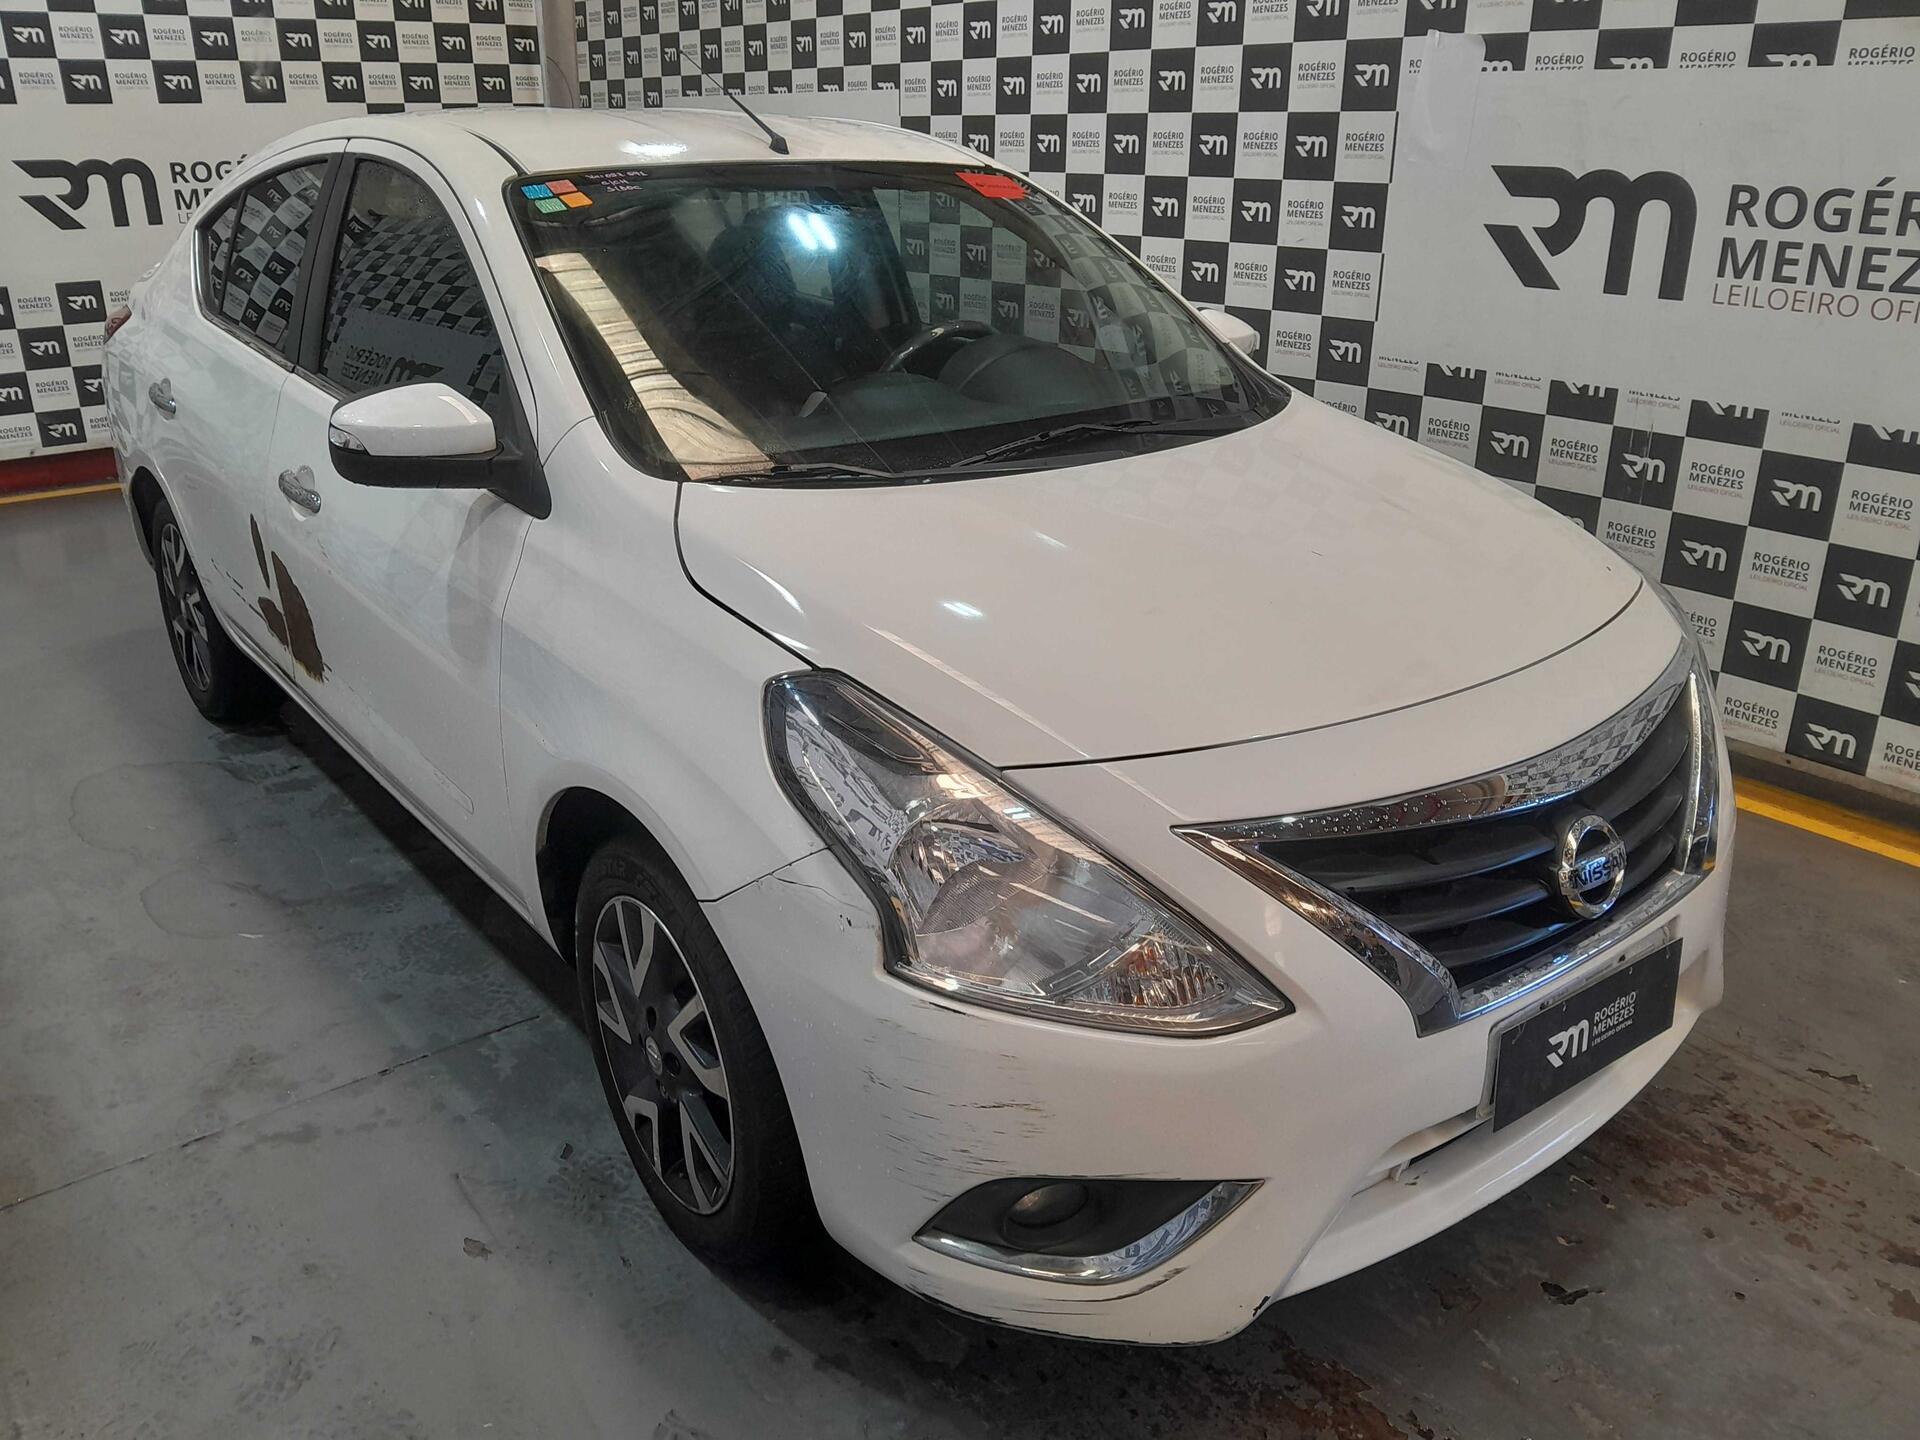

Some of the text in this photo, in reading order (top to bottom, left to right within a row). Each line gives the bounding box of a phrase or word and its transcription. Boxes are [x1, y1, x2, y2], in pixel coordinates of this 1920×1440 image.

[1076, 8, 1104, 17] ROGÉRIO
[1160, 1, 1191, 10] ROGÉRIO
[1207, 0, 1237, 23] RM
[1252, 3, 1288, 14] MENEZES
[1002, 15, 1027, 23] ROGÉRIO
[1076, 17, 1104, 26] MENEZES
[1119, 8, 1145, 29] RM
[1159, 10, 1191, 20] MENEZES
[875, 26, 896, 35] ROGÉRIO
[936, 20, 958, 29] ROGÉRIO
[969, 21, 991, 39] RM
[1002, 23, 1027, 31] MENEZES
[1040, 15, 1064, 34] RM
[11, 26, 46, 43] RM
[109, 29, 140, 45] RM
[200, 31, 228, 46] RM
[285, 33, 312, 48] RM
[366, 34, 391, 49] RM
[820, 31, 839, 39] ROGÉRIO
[849, 31, 866, 48] RM
[906, 26, 925, 44] RM
[442, 36, 466, 50] RM
[514, 38, 535, 52] RM
[796, 36, 812, 52] RM
[1536, 53, 1584, 65] ROGÉRIO
[1680, 49, 1736, 62] ROGÉRIO
[1849, 44, 1915, 59] ROGÉRIO
[1114, 69, 1143, 78] ROGÉRIO
[1201, 65, 1233, 74] ROGÉRIO
[1298, 61, 1336, 72] ROGÉRIO
[70, 74, 102, 90] RM
[164, 75, 193, 90] RM
[331, 75, 357, 90] RM
[905, 78, 926, 86] ROGÉRIO
[967, 75, 991, 83] ROGÉRIO
[1037, 72, 1063, 80] ROGÉRIO
[1114, 77, 1143, 86] MENEZES
[1158, 70, 1186, 91] RM
[1200, 74, 1233, 84] MENEZES
[1250, 67, 1281, 89] RM
[1298, 71, 1335, 81] MENEZES
[1354, 63, 1389, 87] RM
[409, 76, 433, 90] RM
[482, 77, 505, 91] RM
[936, 79, 956, 97] RM
[1002, 76, 1025, 95] RM
[1037, 79, 1063, 88] MENEZES
[1076, 74, 1101, 93] RM
[1000, 131, 1024, 139] ROGÉRIO
[1072, 131, 1100, 140] ROGÉRIO
[1153, 131, 1184, 140] ROGÉRIO
[1243, 132, 1278, 141] ROGÉRIO
[1346, 132, 1385, 142] ROGÉRIO
[1000, 139, 1024, 147] MENEZES
[1037, 134, 1060, 152] RM
[1072, 139, 1100, 147] MENEZES
[1113, 134, 1139, 154] RM
[1152, 139, 1184, 149] MENEZES
[1199, 135, 1228, 156] RM
[1243, 141, 1278, 150] MENEZES
[1295, 135, 1328, 158] RM
[1345, 142, 1384, 152] MENEZES
[12, 158, 164, 230] RM
[1109, 191, 1137, 201] ROGÉRIO
[1193, 195, 1225, 205] ROGÉRIO
[1108, 200, 1137, 210] MENEZES
[1151, 197, 1178, 217] RM
[1192, 204, 1225, 215] MENEZES
[1241, 200, 1271, 222] RM
[1287, 199, 1323, 210] ROGÉRIO
[1287, 208, 1323, 220] MENEZES
[1341, 206, 1375, 229] RM
[1483, 164, 1698, 301] RM
[1146, 254, 1176, 265] ROGÉRIO
[1234, 262, 1268, 272] ROGÉRIO
[1191, 261, 1219, 283] RM
[1233, 271, 1267, 281] MENEZES
[1333, 270, 1371, 281] ROGÉRIO
[1284, 269, 1316, 292] RM
[1332, 280, 1370, 290] MENEZES
[18, 296, 51, 304] ROGÉRIO
[68, 295, 97, 310] RM
[1712, 283, 1860, 318] LEILOEIRO
[1277, 330, 1312, 341] ROGÉRIO
[30, 340, 60, 356] RM
[1276, 339, 1311, 350] MENEZES
[1329, 339, 1361, 364] RM
[35, 380, 68, 388] ROGÉRIO
[48, 422, 76, 438] RM
[1428, 418, 1470, 431] ROGÉRIO
[1427, 428, 1469, 441] MENEZES
[1490, 431, 1529, 458] RM
[1551, 438, 1598, 453] ROGÉRIO
[1550, 448, 1598, 464] MENEZES
[1621, 453, 1666, 483] RM
[1691, 461, 1745, 479] ROGÉRIO
[1688, 472, 1744, 490] MENEZES
[1770, 479, 1822, 512] RM
[1852, 489, 1913, 509] ROGÉRIO
[1849, 501, 1911, 521] MENEZES
[1608, 521, 1656, 539] ROGÉRIO
[1606, 531, 1655, 549] MENEZES
[1680, 539, 1727, 572] RM
[1754, 552, 1810, 572] ROGÉRIO
[1751, 562, 1809, 582] MENEZES
[1836, 573, 1891, 608] RM
[1741, 630, 1791, 663] RM
[1818, 645, 1878, 668] ROGÉRIO
[1816, 656, 1876, 678] MENEZES
[1725, 697, 1779, 719] ROGÉRIO
[1723, 707, 1777, 730] MENEZES
[1804, 723, 1856, 759] RM
[1577, 847, 1626, 886] NISSAN
[1594, 992, 1636, 1022] ROGÉRIO
[1592, 1004, 1635, 1036] MENEZES
[1546, 1019, 1589, 1068] RM
